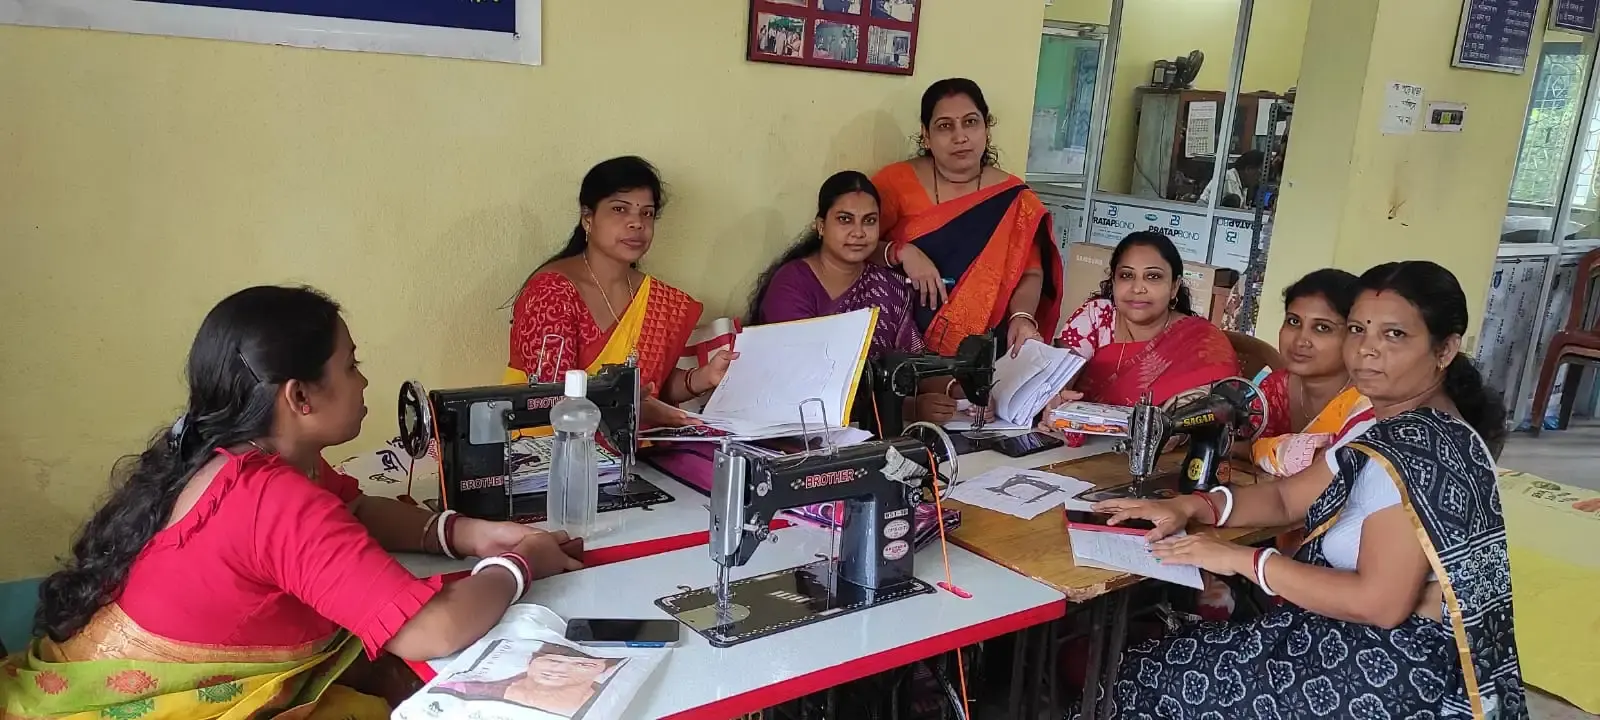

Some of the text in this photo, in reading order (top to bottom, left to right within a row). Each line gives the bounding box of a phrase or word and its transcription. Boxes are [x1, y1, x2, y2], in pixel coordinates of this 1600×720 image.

[1092, 216, 1135, 231] RATAPBOND
[1148, 225, 1200, 241] PRATAPBOND
[1183, 413, 1215, 427] SAGAR
[805, 468, 855, 489] BROTHER
